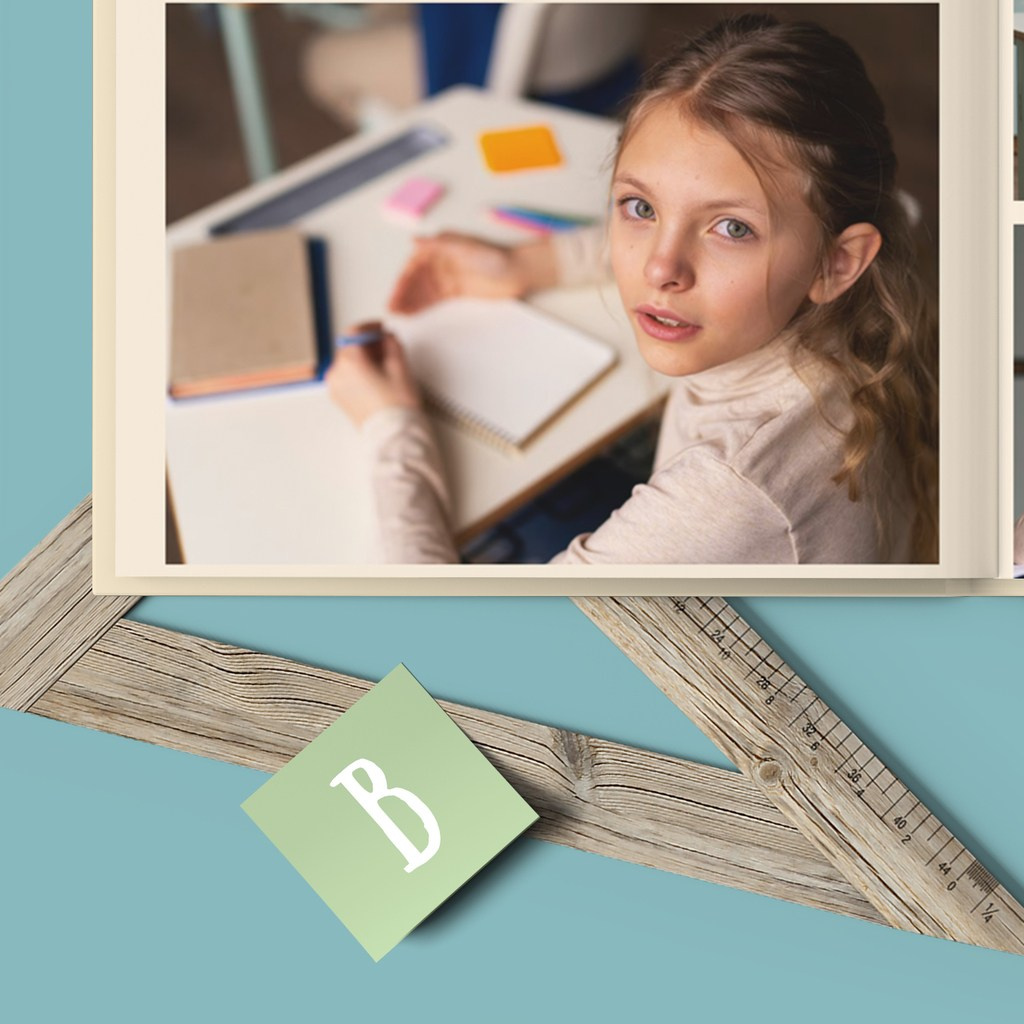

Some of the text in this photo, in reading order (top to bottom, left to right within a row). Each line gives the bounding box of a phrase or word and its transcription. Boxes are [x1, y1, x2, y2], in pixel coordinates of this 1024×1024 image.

[764, 695, 775, 705] 8
[802, 721, 817, 738] 32
[810, 741, 821, 751] 6
[847, 768, 863, 784] 36
[893, 816, 908, 830] 40
[901, 834, 912, 845] 2
[938, 862, 952, 876] 44
[946, 880, 957, 891] 0
